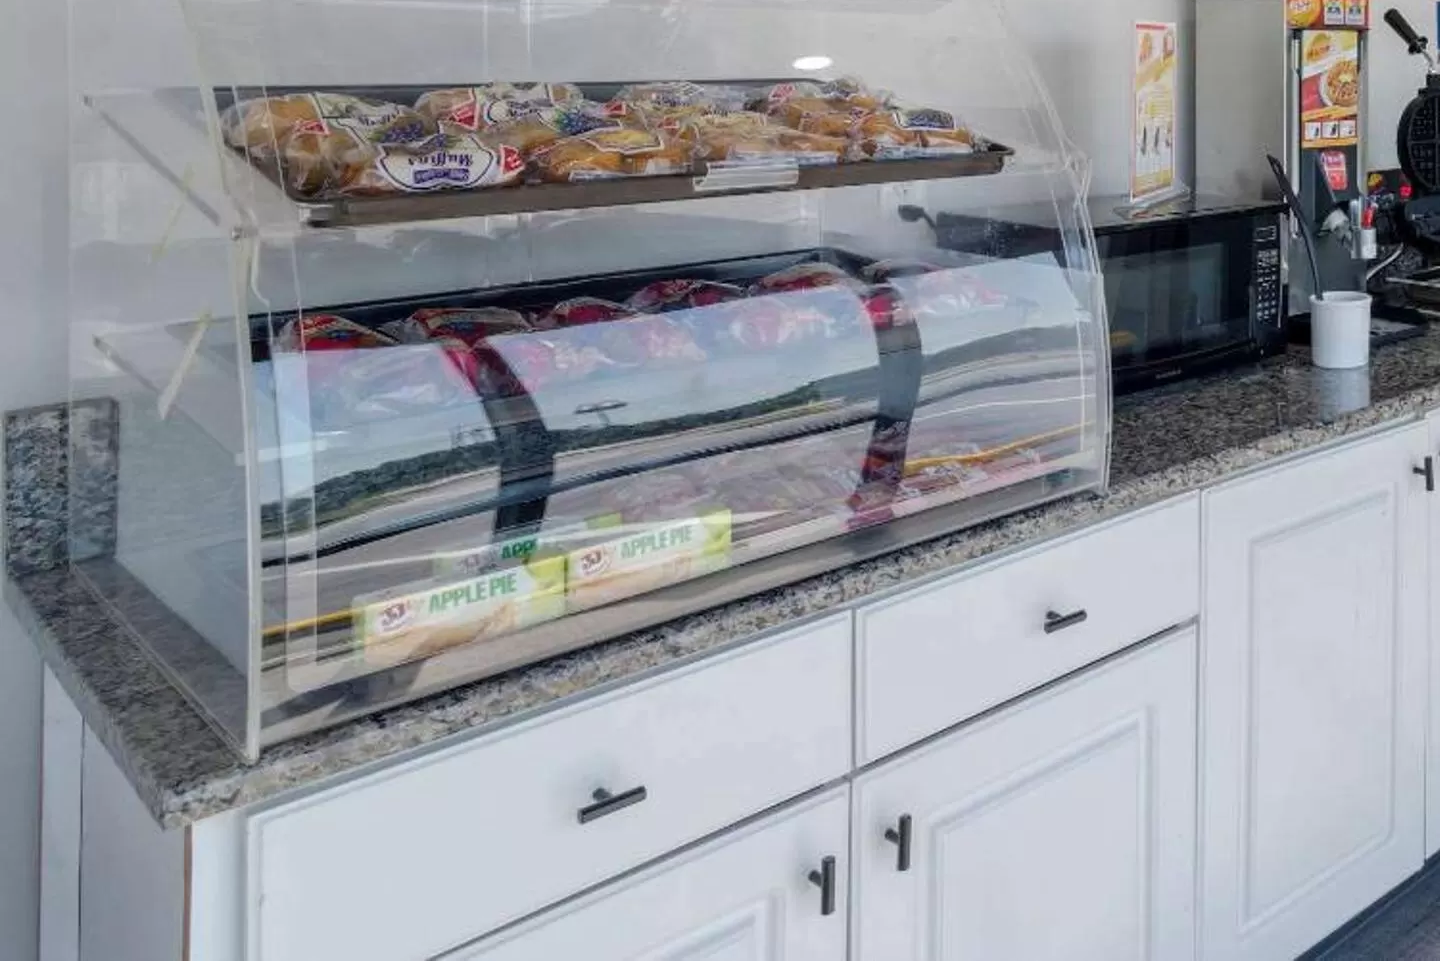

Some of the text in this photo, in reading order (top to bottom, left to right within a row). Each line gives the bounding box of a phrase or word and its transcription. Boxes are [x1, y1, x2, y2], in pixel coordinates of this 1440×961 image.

[619, 529, 668, 559] APPLE
[669, 525, 693, 547] PIE
[427, 580, 488, 614] APPLE
[489, 572, 518, 598] PIE
